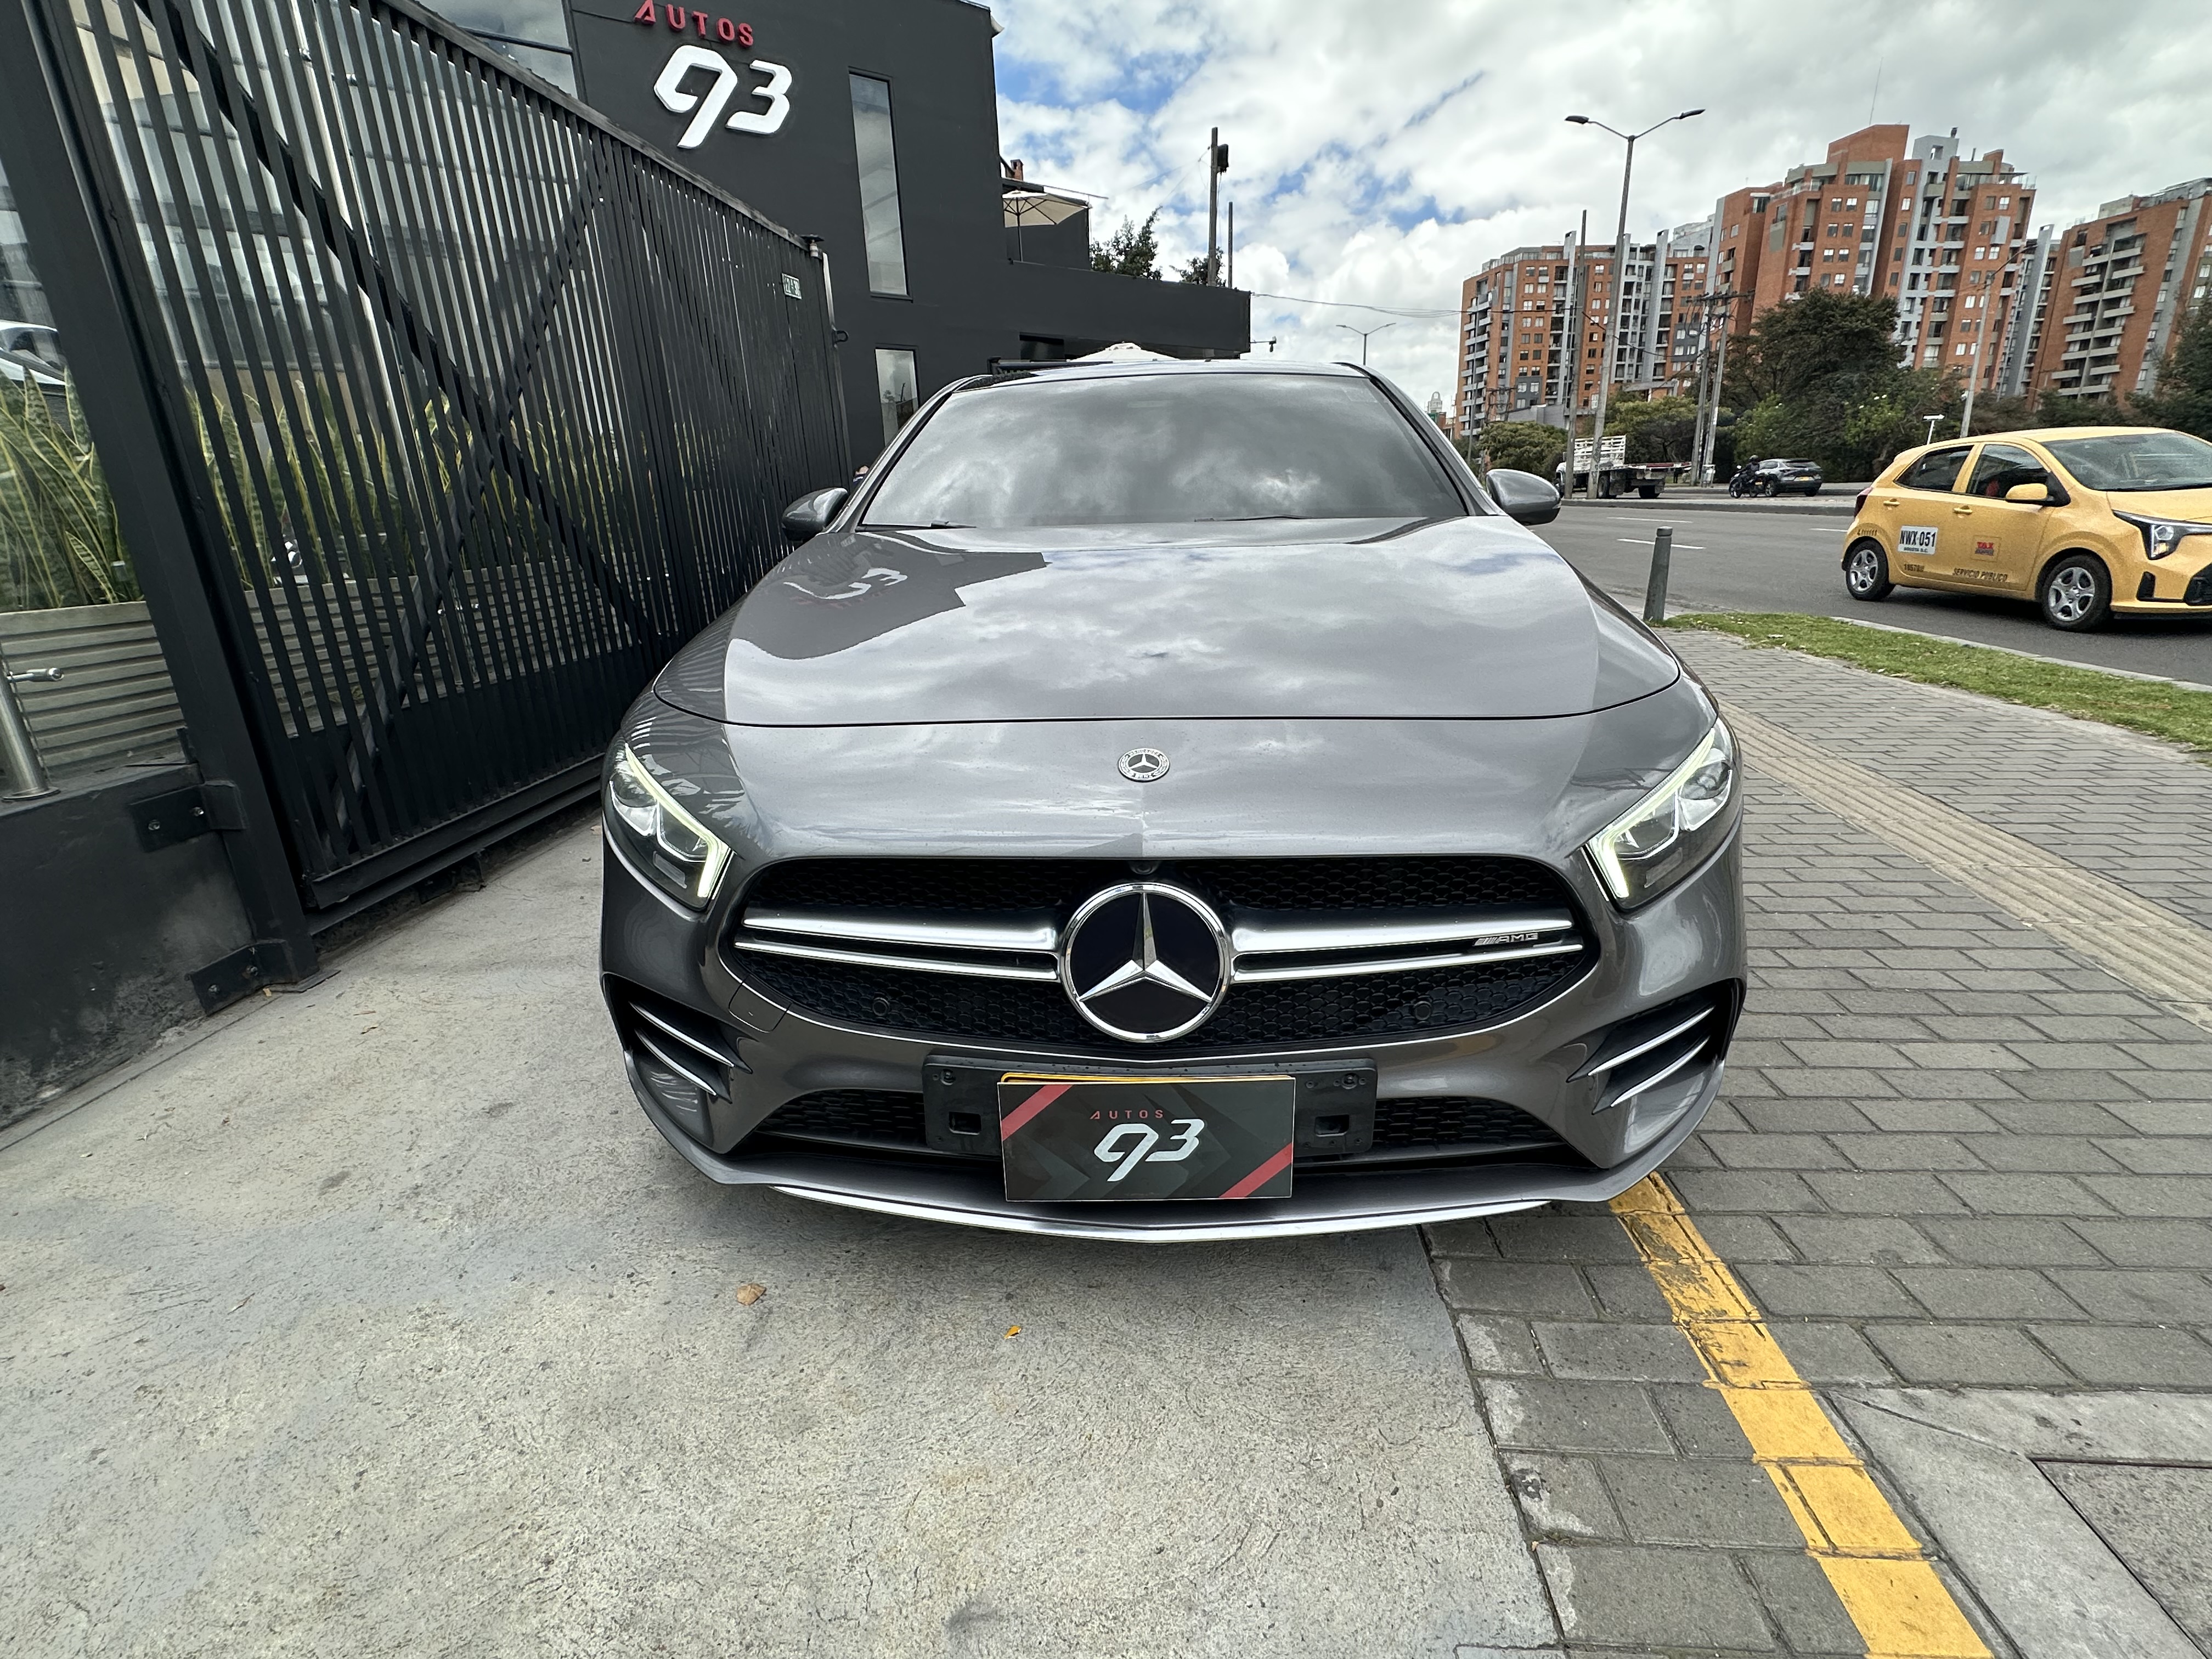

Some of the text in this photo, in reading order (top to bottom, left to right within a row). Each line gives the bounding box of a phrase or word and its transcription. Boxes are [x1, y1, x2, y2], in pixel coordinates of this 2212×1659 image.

[634, 0, 754, 47] AUTOS
[653, 44, 792, 149] 93
[1495, 933, 1538, 944] AMG
[1090, 1109, 1164, 1120] AUTOS
[1094, 1119, 1205, 1182] 93
